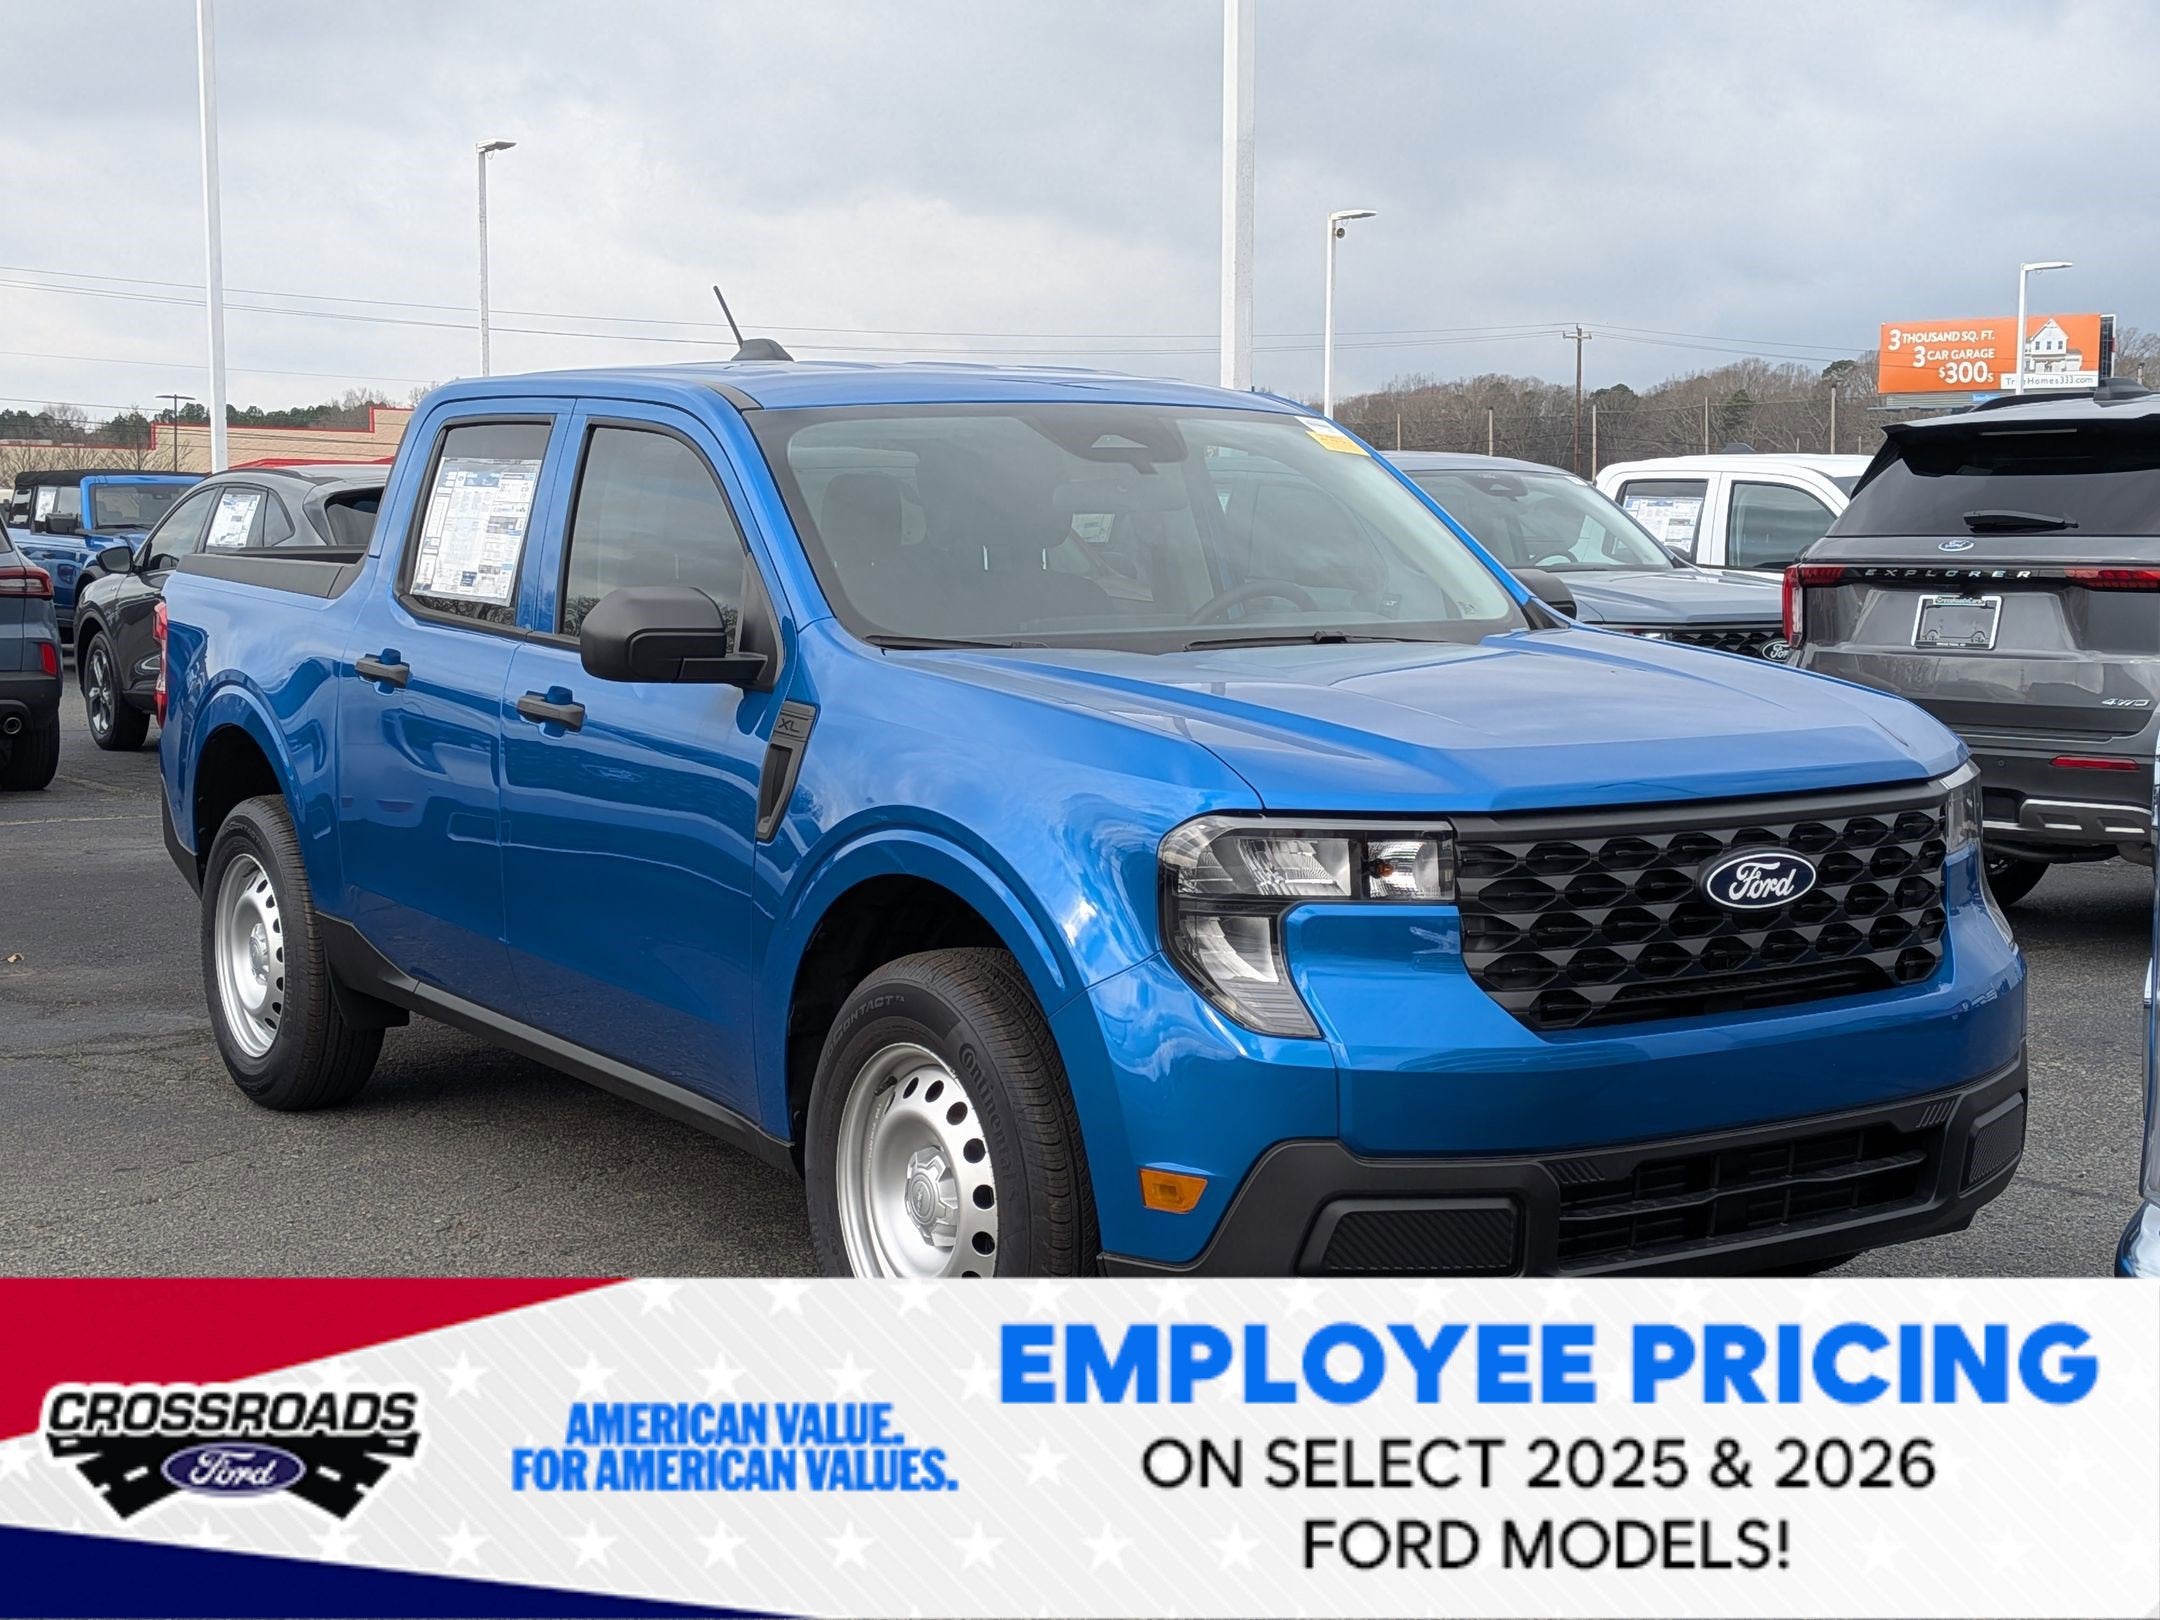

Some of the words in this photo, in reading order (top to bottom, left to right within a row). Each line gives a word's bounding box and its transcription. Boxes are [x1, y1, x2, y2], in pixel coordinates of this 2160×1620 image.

[1888, 329, 1901, 351] 3
[1902, 331, 1960, 344] THOUSAND
[1961, 331, 1979, 343] SQ.
[1981, 330, 1995, 341] FT.
[1912, 345, 1926, 368] 3
[1927, 350, 1949, 361] CAR
[1950, 348, 1995, 360] GARAGE
[2006, 375, 2093, 385] TrHomes333.com
[1865, 568, 2031, 578] EXPLORER
[1770, 643, 1789, 659] For
[2102, 698, 2150, 707] 4WD
[778, 718, 800, 733] XL
[1729, 861, 1797, 900] Ford
